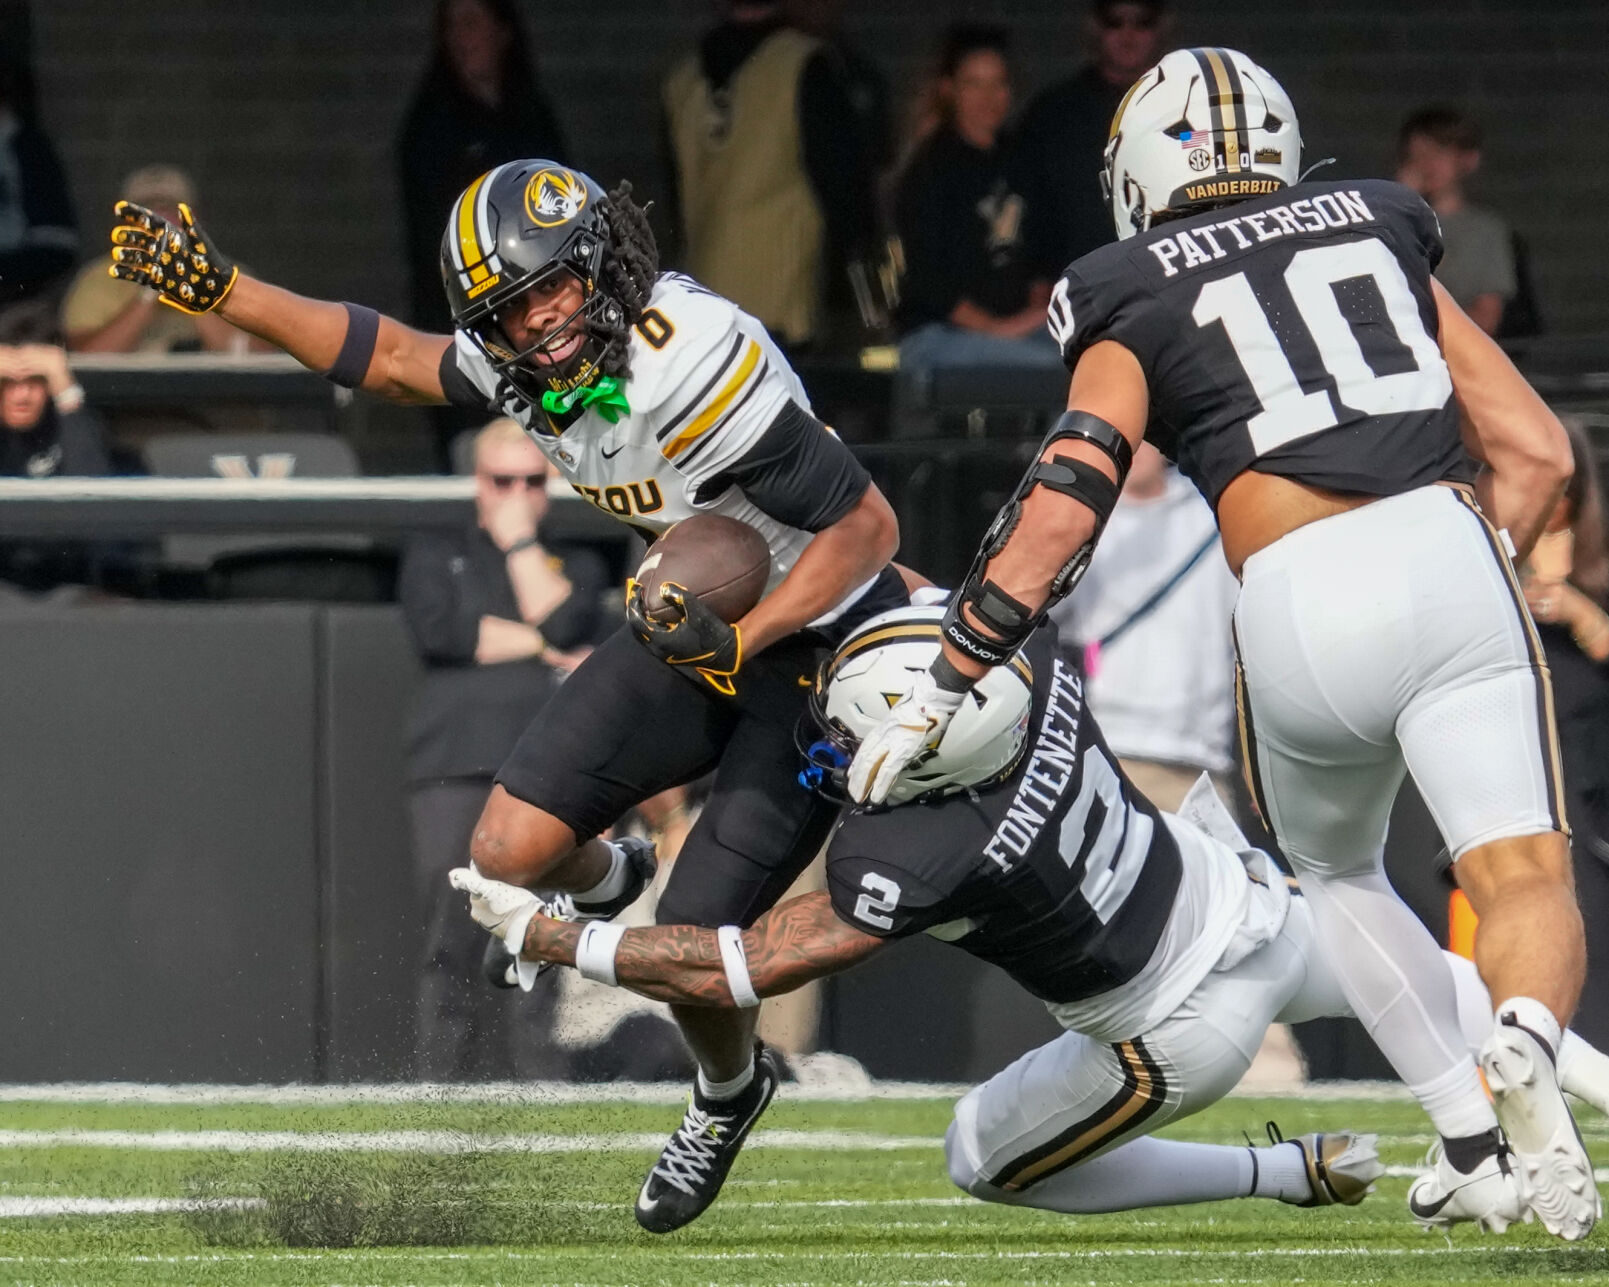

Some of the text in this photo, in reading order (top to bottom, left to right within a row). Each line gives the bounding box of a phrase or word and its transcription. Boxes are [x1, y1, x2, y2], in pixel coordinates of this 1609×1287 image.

[1186, 180, 1280, 200] VANDERBILT
[1148, 190, 1375, 277] PATTERSON
[634, 307, 676, 352] 0
[1046, 276, 1075, 356] 0
[1192, 237, 1453, 457] 10
[571, 476, 664, 517] ZOU
[948, 626, 1001, 661] DONJOY
[982, 657, 1083, 874] FONTENETTE
[1058, 744, 1155, 926] 2
[853, 872, 901, 930] 2
